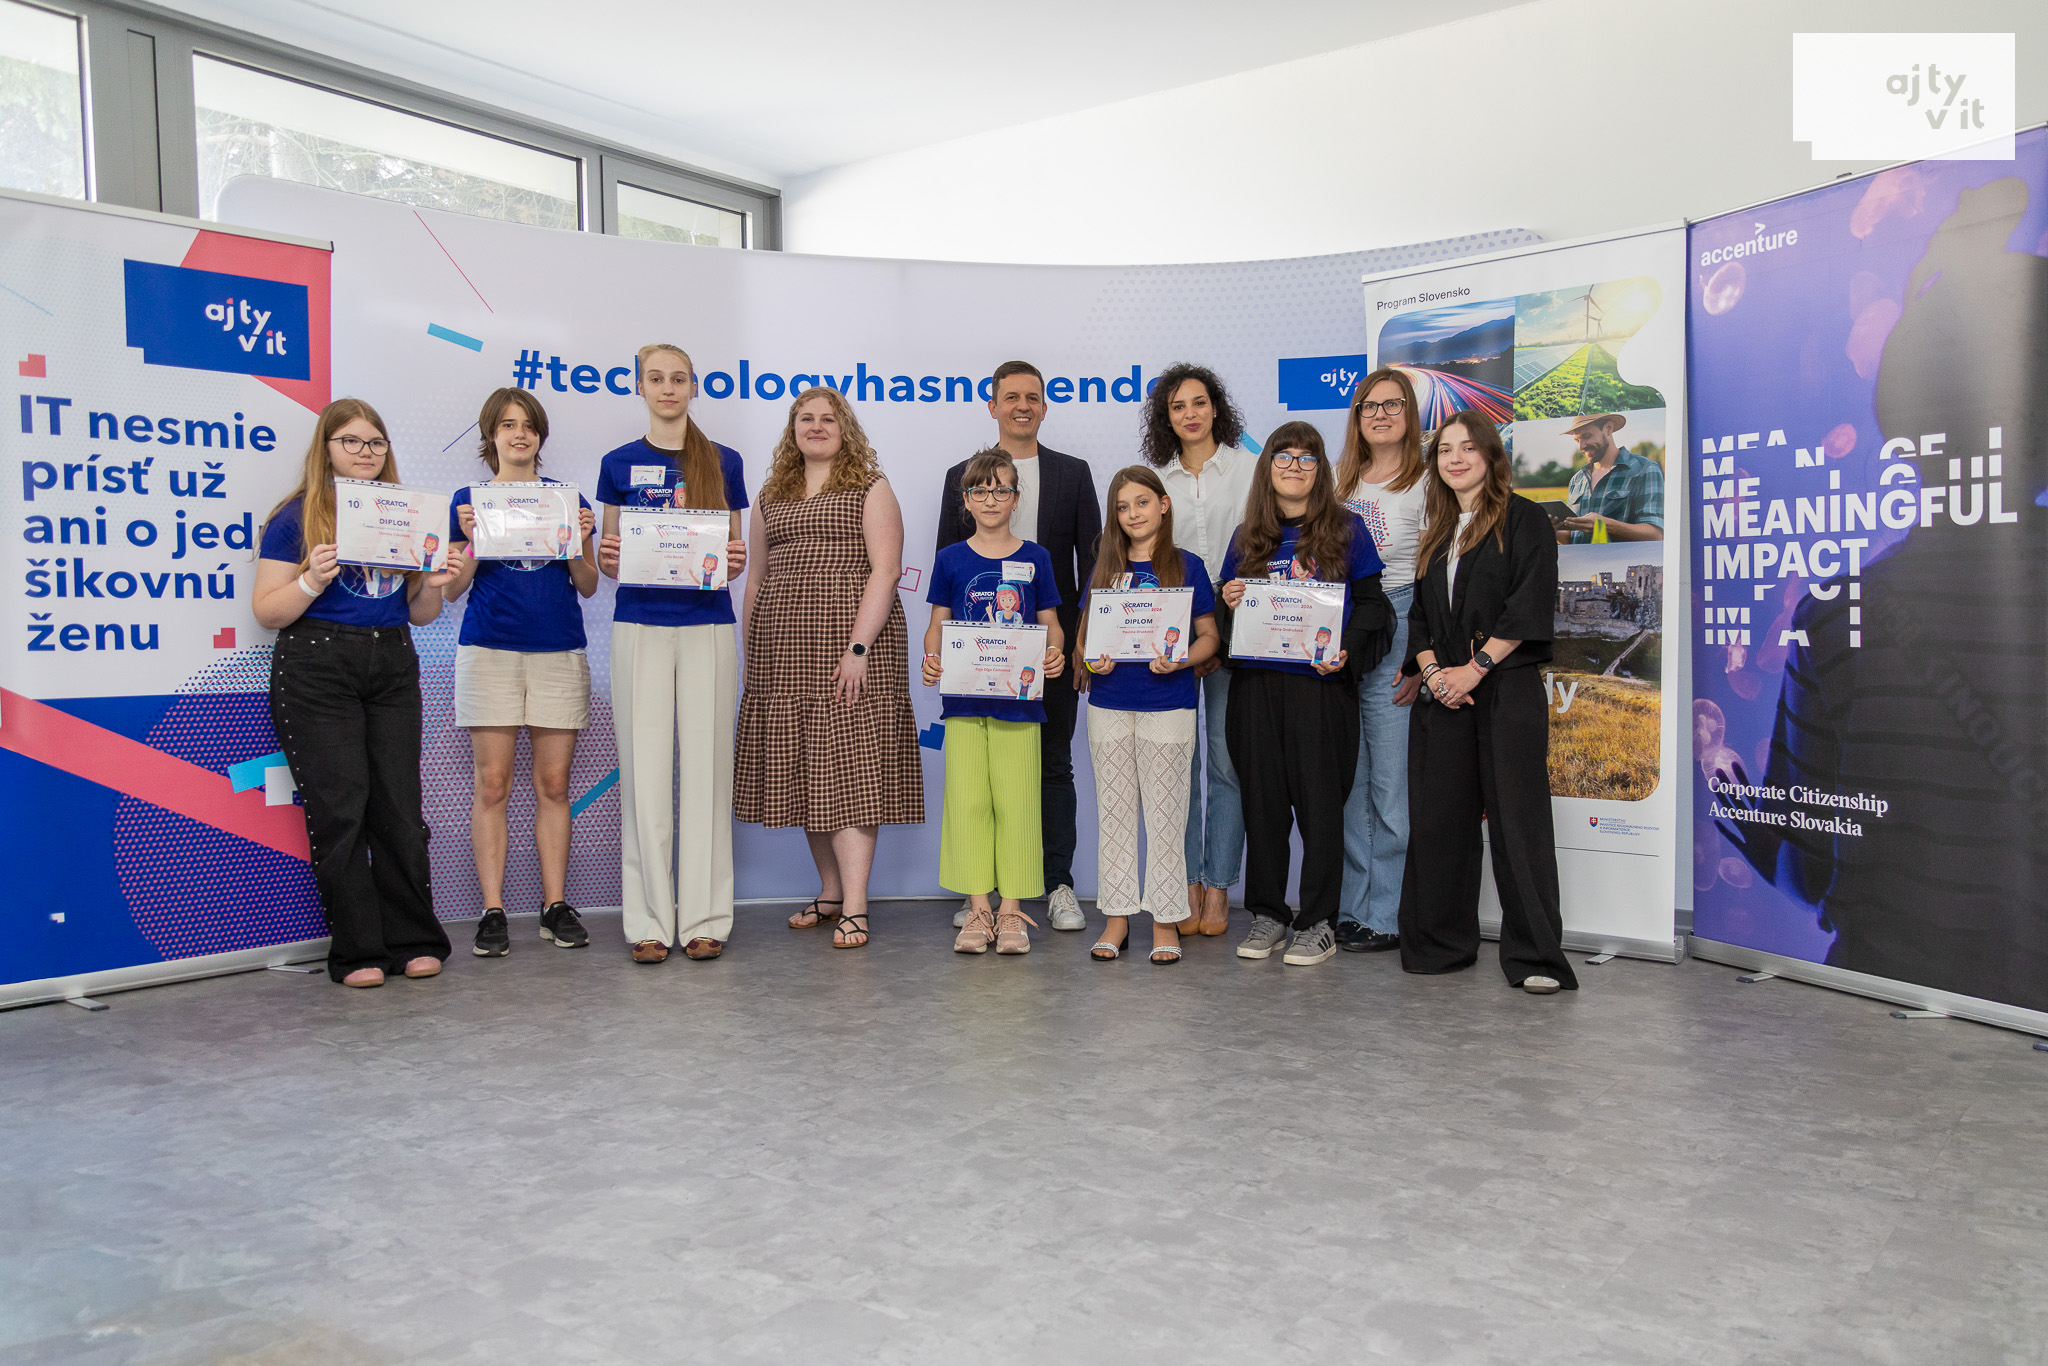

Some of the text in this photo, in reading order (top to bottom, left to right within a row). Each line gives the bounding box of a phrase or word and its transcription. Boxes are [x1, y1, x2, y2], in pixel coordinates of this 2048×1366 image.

[1700, 224, 1798, 266] accenture
[1376, 287, 1470, 310] Program Slovensko
[20, 394, 277, 452] IT nesmie
[22, 453, 226, 502] prísť už
[348, 500, 360, 508] 10
[377, 498, 408, 508] SCRATCH
[380, 518, 410, 526] DIPLOM
[1702, 482, 2018, 538] MEANINGFUL
[22, 506, 264, 560] ani o jed
[24, 556, 236, 600] šikovnú
[1704, 538, 1868, 580] IMPACT
[26, 612, 160, 652] ženu
[1707, 776, 1888, 818] Corporate Citizenship
[1708, 801, 1863, 837] Accenture Slovakia
